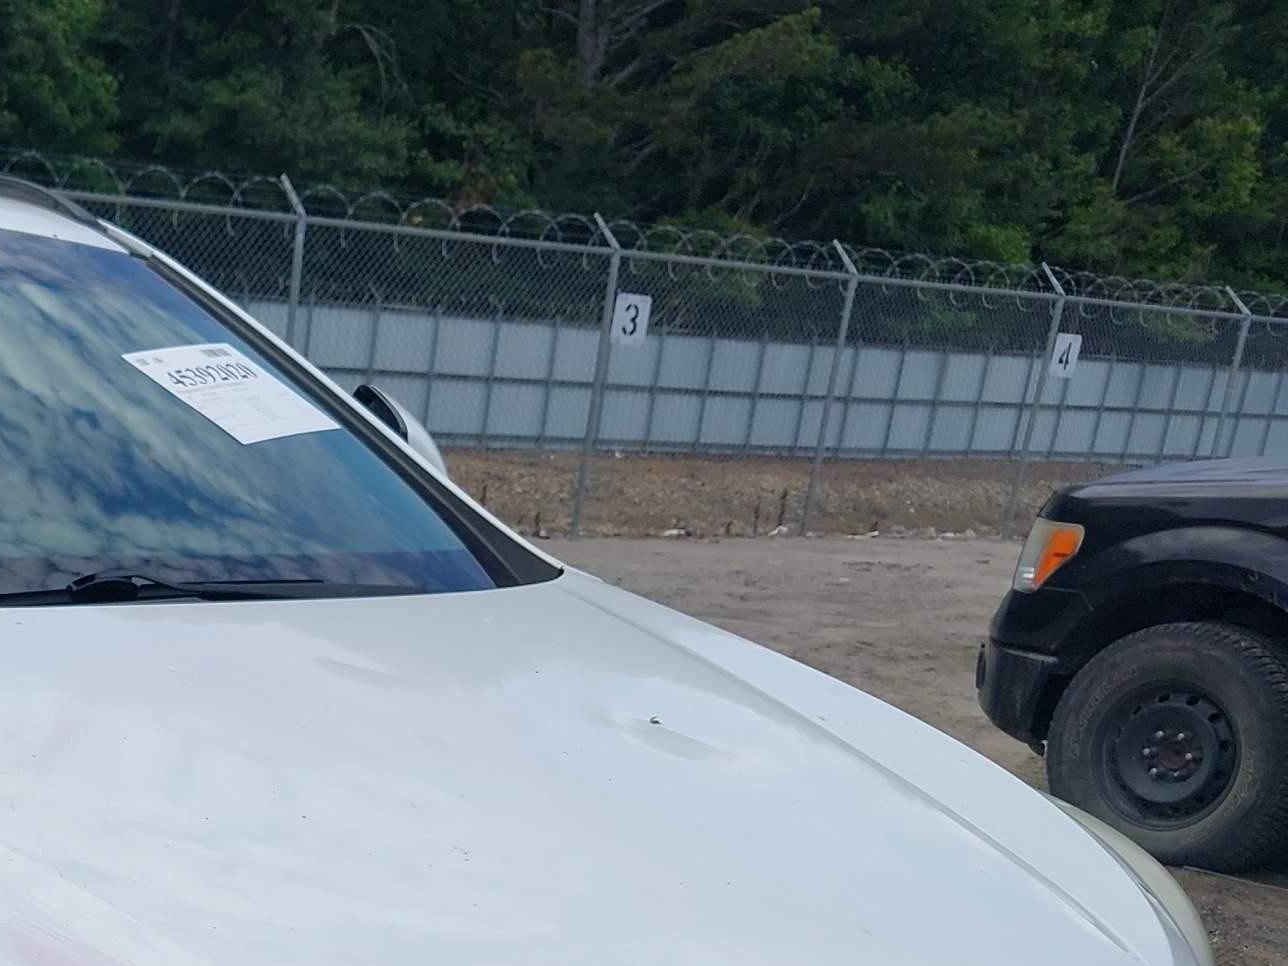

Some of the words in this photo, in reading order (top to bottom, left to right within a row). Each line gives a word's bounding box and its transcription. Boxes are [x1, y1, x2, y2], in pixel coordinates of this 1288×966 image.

[622, 303, 639, 336] 3
[1058, 341, 1072, 370] 4
[167, 363, 258, 388] 45392020
